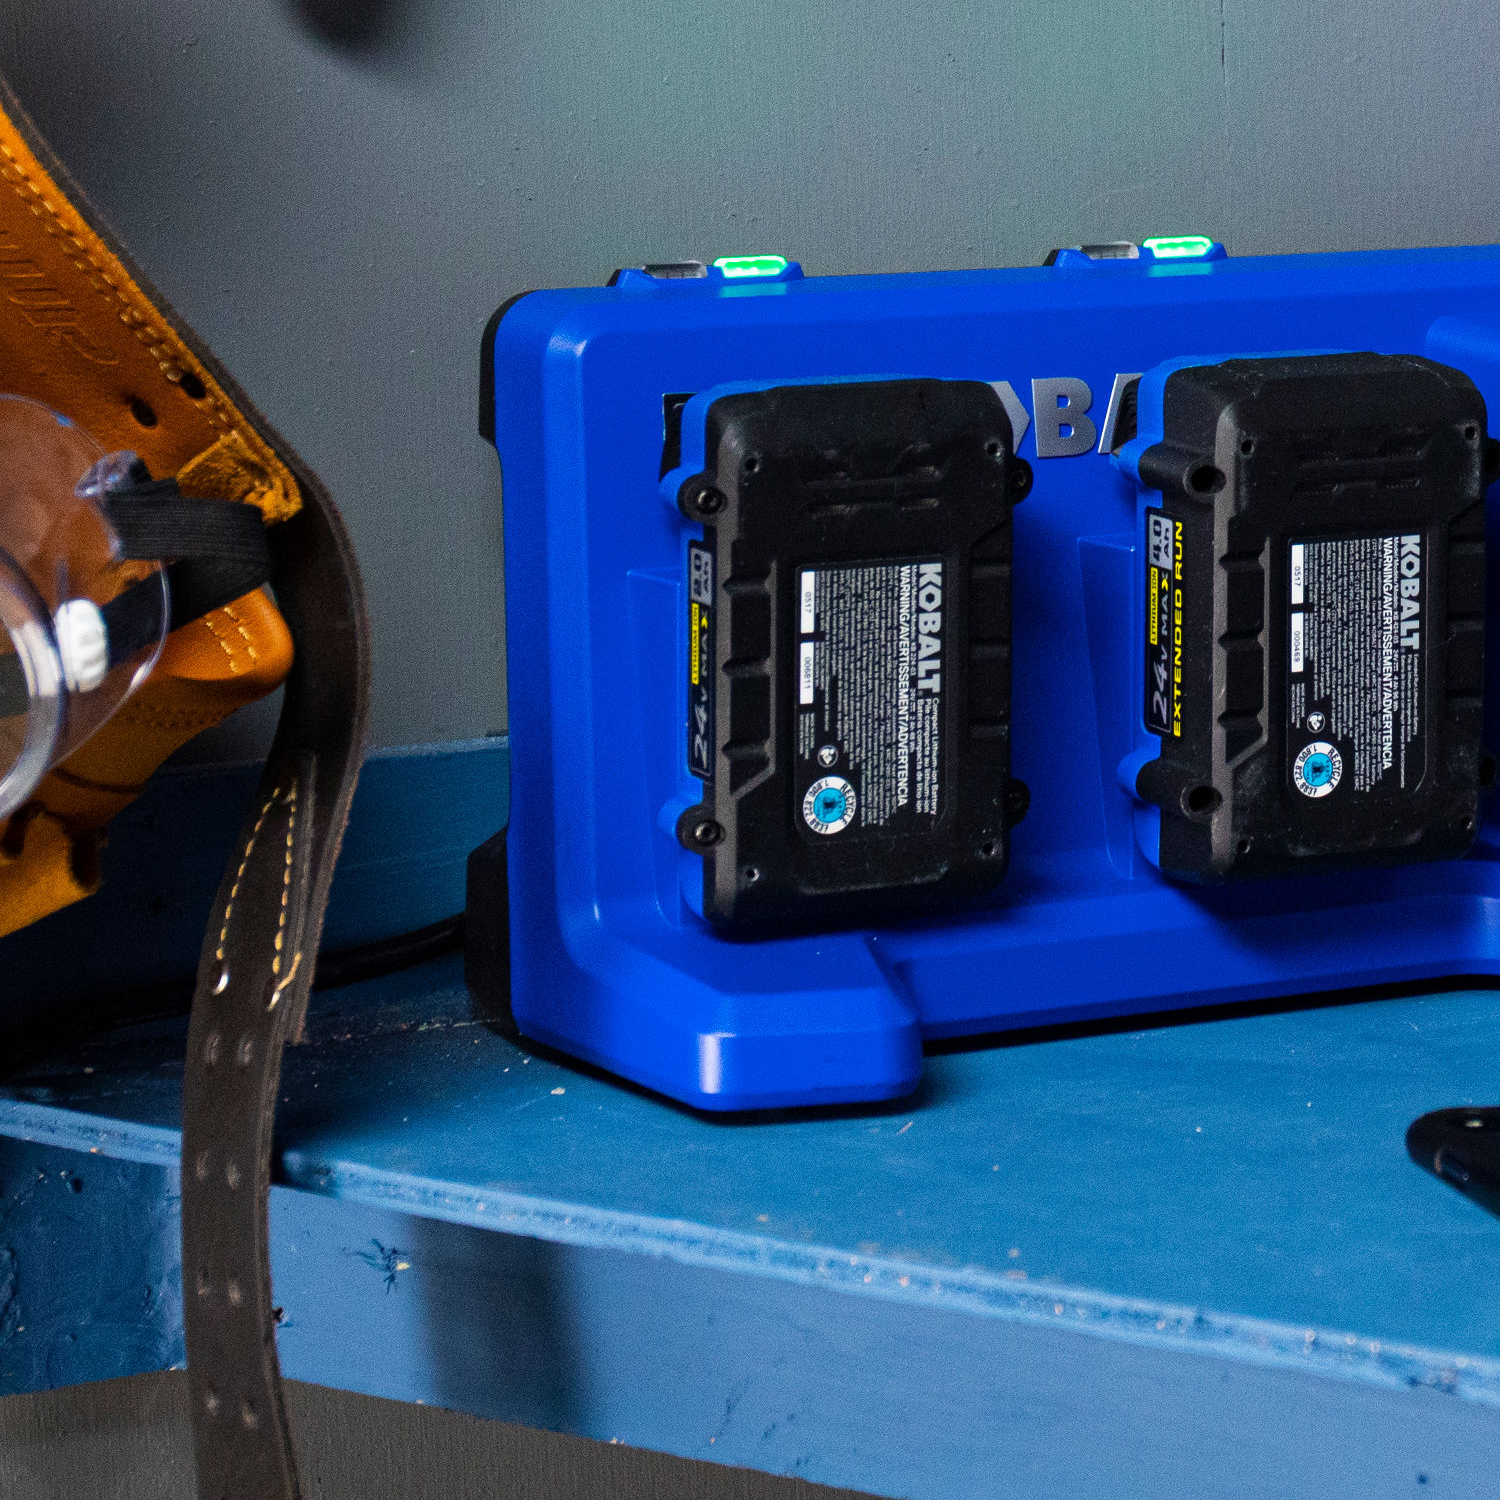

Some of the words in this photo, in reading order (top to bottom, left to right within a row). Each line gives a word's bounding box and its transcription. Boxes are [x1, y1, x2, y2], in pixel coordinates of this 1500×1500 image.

[1152, 520, 1162, 563] 4.0
[1163, 527, 1170, 559] Ah
[1174, 521, 1183, 580] RUN
[1294, 566, 1302, 586] 0517
[1400, 534, 1420, 650] KOBALT
[918, 563, 942, 692] KOBALT
[1174, 588, 1182, 738] EXTENDED
[1382, 537, 1392, 770] WARNING/AVERTISSEMENT/ADVERTENCIA
[898, 566, 910, 806] WARNING/AVERTISSEMENT/ADVERTENCIA
[931, 698, 939, 734] Compact
[1294, 744, 1318, 796] 1.800.822.8837
[1327, 748, 1341, 788] RECYCLE
[840, 783, 856, 824] RECYCLE
[930, 784, 938, 814] Battery
